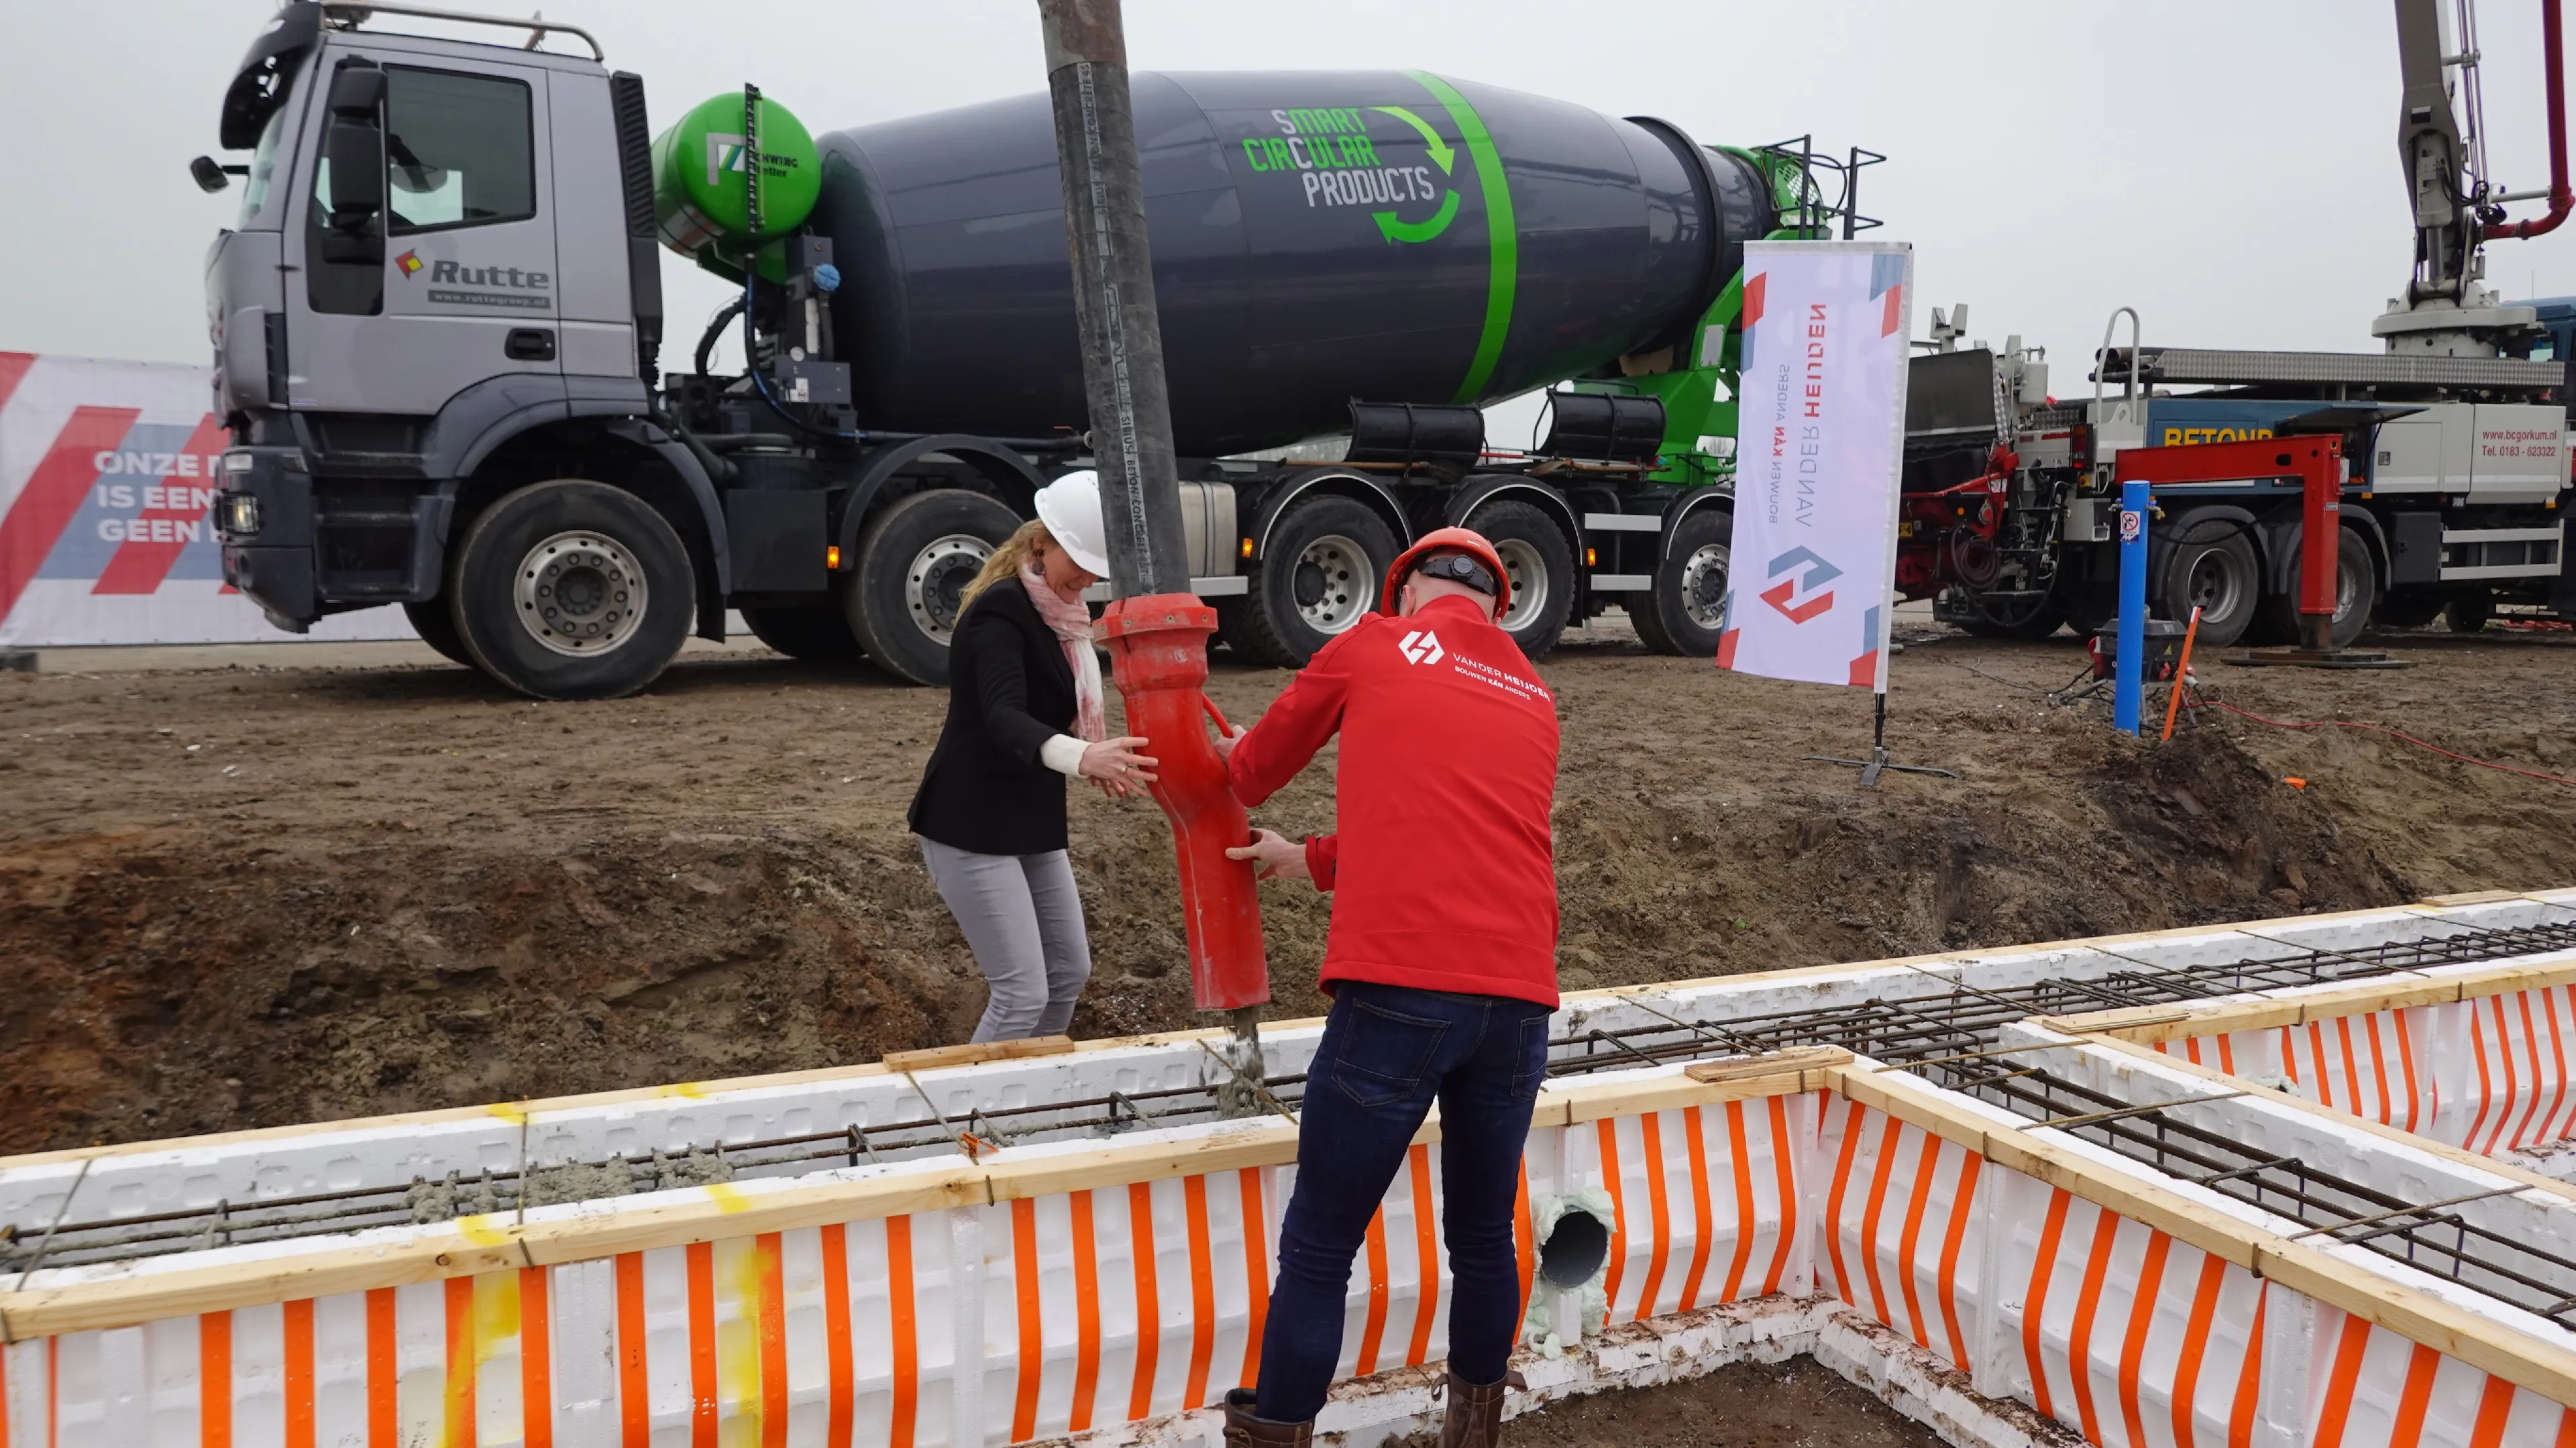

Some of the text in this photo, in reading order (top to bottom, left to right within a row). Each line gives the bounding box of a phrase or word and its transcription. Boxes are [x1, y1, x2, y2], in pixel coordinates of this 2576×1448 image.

[1271, 108, 1366, 134] SMART
[754, 152, 798, 168] CHWING
[1243, 135, 1381, 171] CIRCULAR
[1302, 166, 1435, 207] PRODUCTS
[431, 260, 549, 290] Rutte
[2482, 430, 2557, 443] www.bcgorkum.nl
[2482, 445, 2497, 456] Tel.
[2500, 446, 2520, 456] 0183
[2526, 446, 2555, 457] 623322
[94, 451, 200, 478] ONZE
[97, 484, 218, 510] IS EEN
[97, 518, 201, 543] GEEN
[1452, 653, 1551, 702] VAN DER HEIJDEN
[1454, 665, 1487, 682] BOUWEN
[1505, 685, 1532, 700] ANDERS
